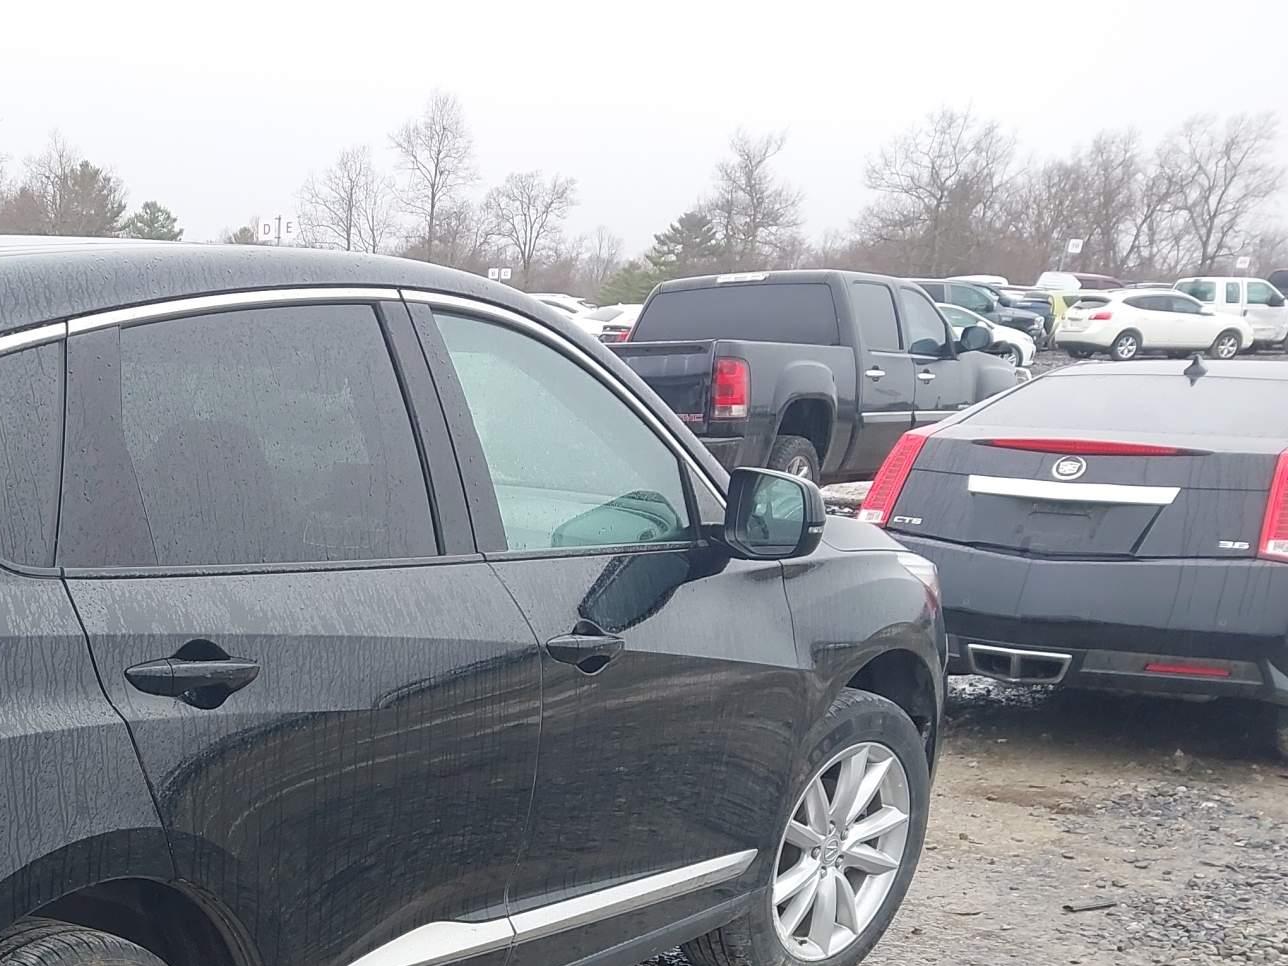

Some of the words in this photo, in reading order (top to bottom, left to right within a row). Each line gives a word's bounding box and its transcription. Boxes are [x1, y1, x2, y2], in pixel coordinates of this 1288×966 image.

[263, 223, 271, 235] D
[286, 221, 293, 234] E
[893, 515, 923, 525] CTS
